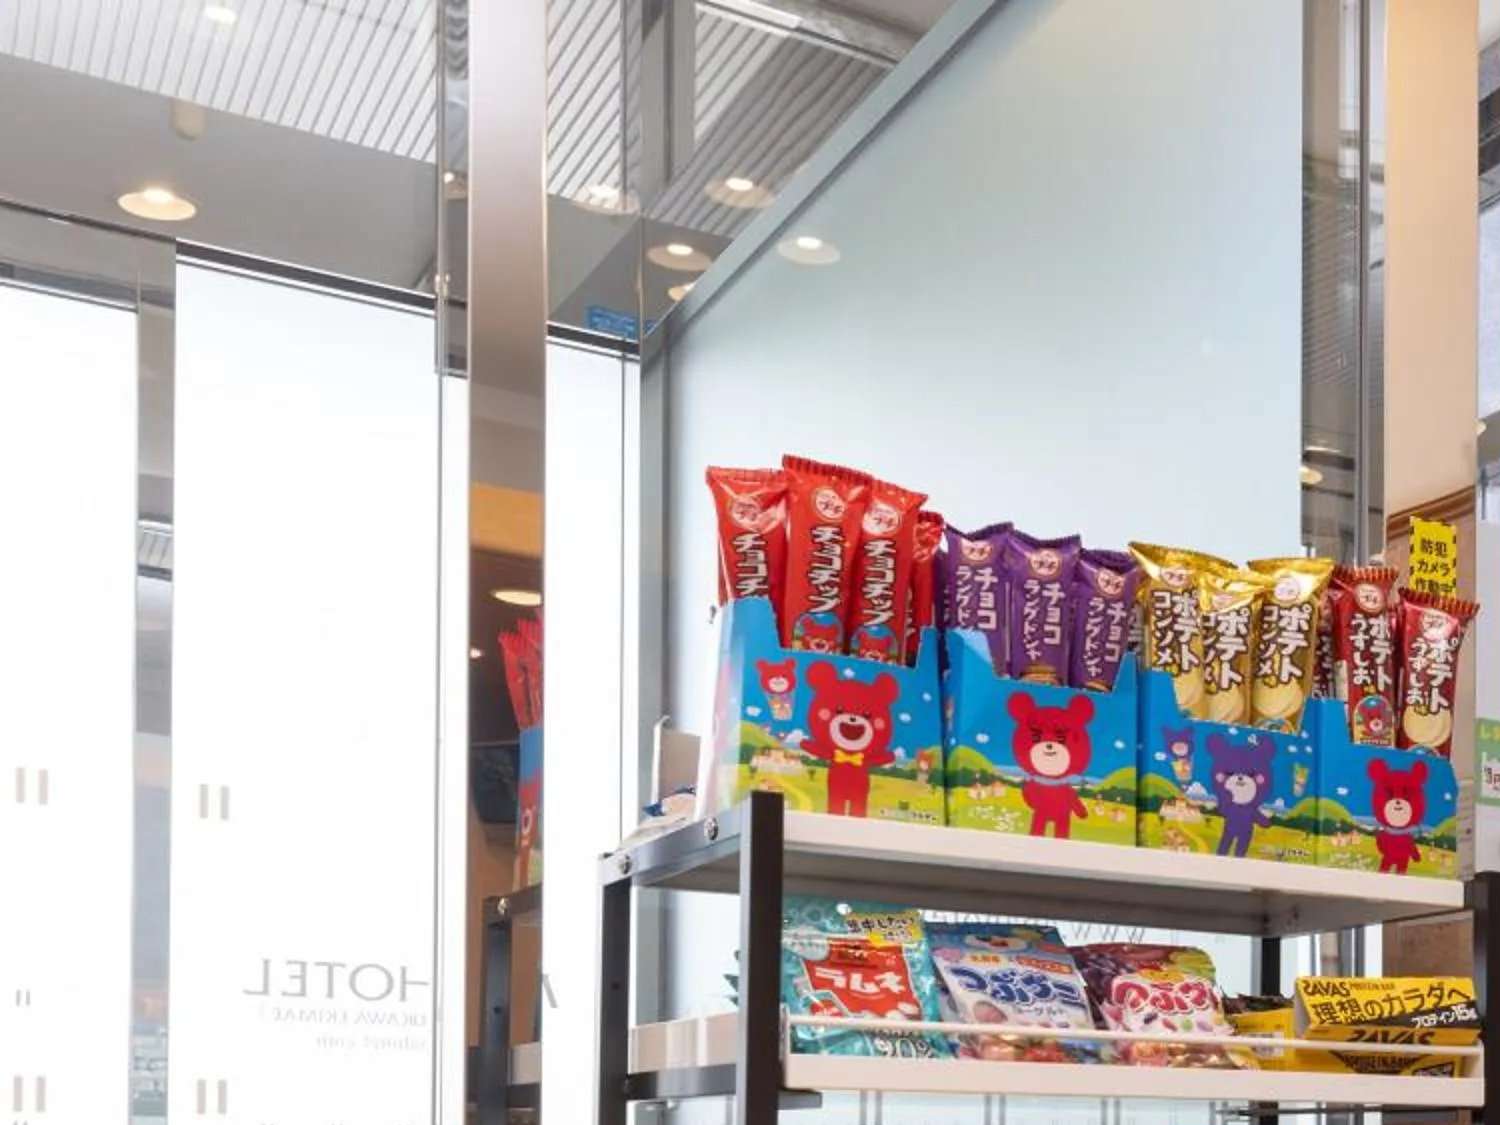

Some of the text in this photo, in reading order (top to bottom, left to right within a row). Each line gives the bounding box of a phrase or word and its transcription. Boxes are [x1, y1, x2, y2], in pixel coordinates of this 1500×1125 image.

[808, 525, 845, 613] チョコチップ
[1417, 561, 1450, 577] カメラ
[1421, 538, 1448, 553] 防犯
[862, 539, 896, 626] チョコチップ
[975, 568, 998, 630] チョコ
[1043, 583, 1066, 645] チョコ
[1023, 579, 1041, 661] ラングドシャ
[1083, 597, 1105, 677] ラングドシャ
[1105, 601, 1127, 663] チョコ
[1153, 591, 1173, 665] コンソメ
[1172, 590, 1200, 671] ポテト
[1216, 608, 1250, 689] ポテト
[1258, 605, 1279, 675] コンソメ
[1277, 604, 1312, 683] ポテト
[1350, 614, 1375, 684] うすしお
[1405, 638, 1429, 704] うすしお
[1428, 637, 1459, 713] ポテト
[815, 967, 906, 993] ラムネ
[1312, 981, 1471, 1024] 理想のカラダへ
